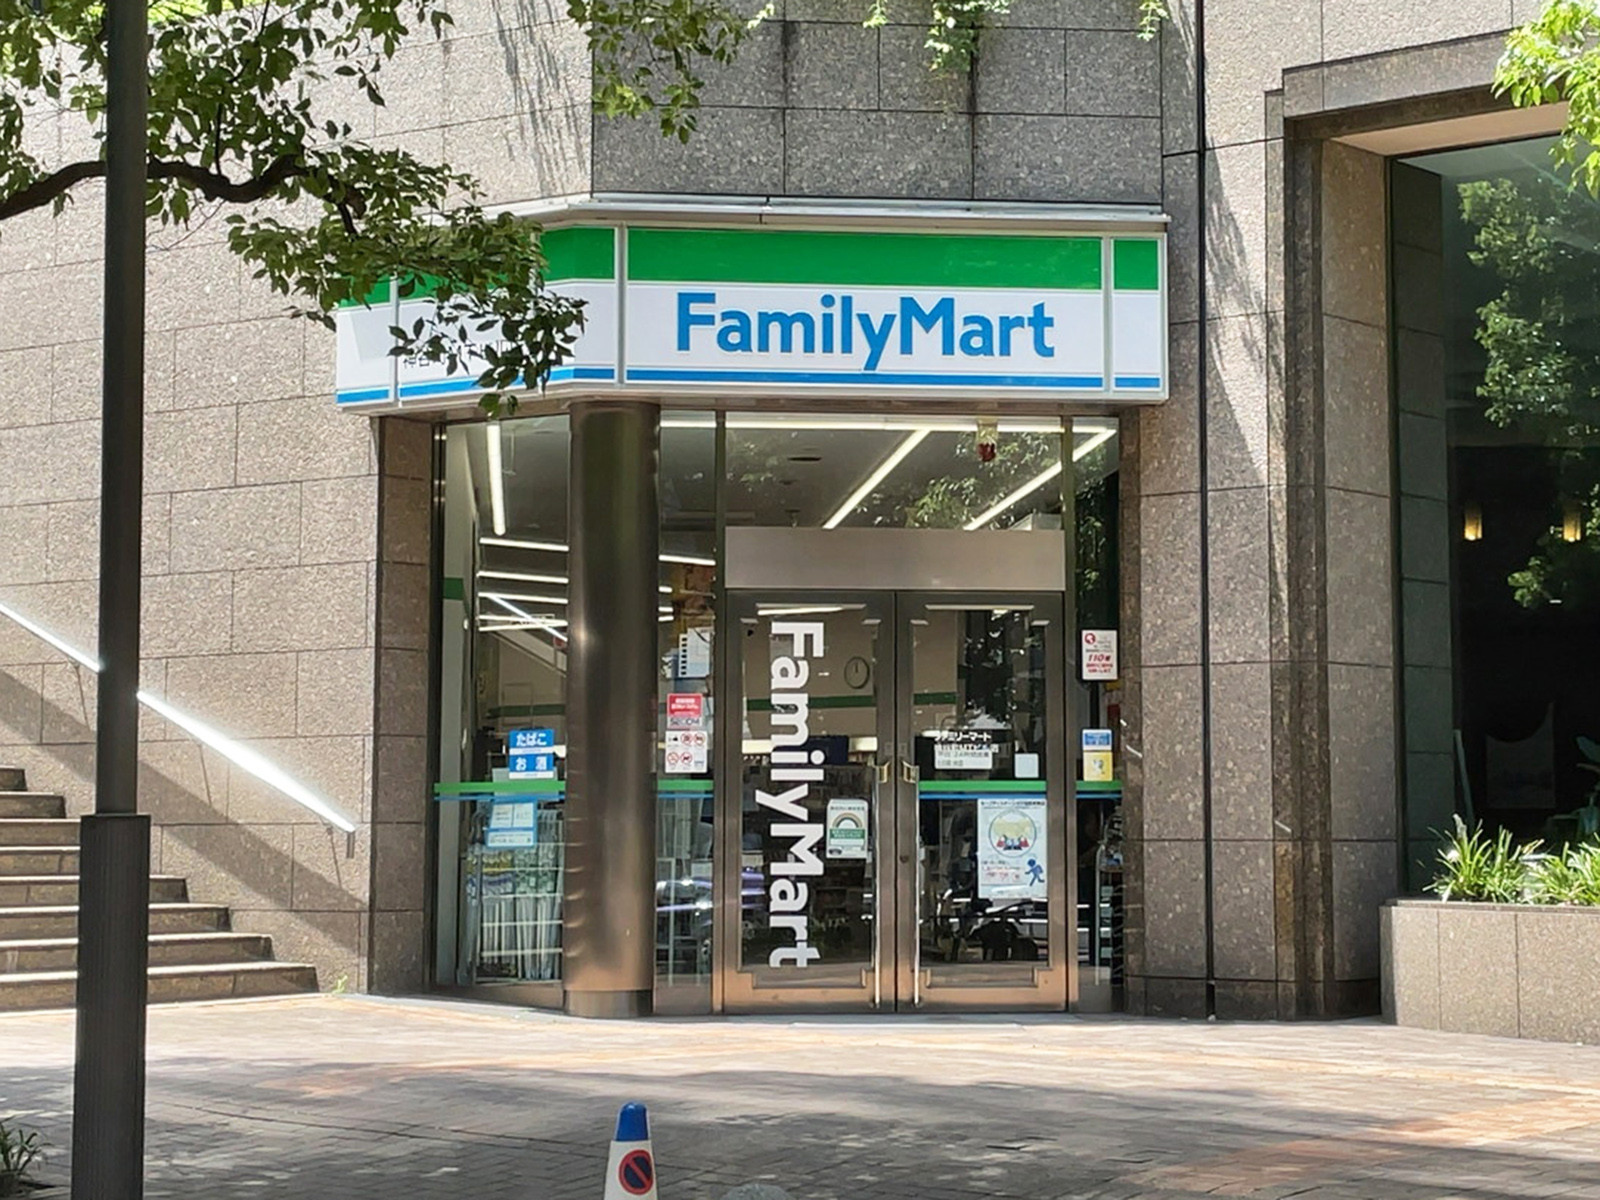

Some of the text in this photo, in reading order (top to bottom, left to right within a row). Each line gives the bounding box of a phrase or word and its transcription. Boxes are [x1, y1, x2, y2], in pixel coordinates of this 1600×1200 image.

[677, 292, 1055, 371] FamilyMart
[516, 733, 548, 747] たばこ
[755, 622, 825, 968] FamilyMart
